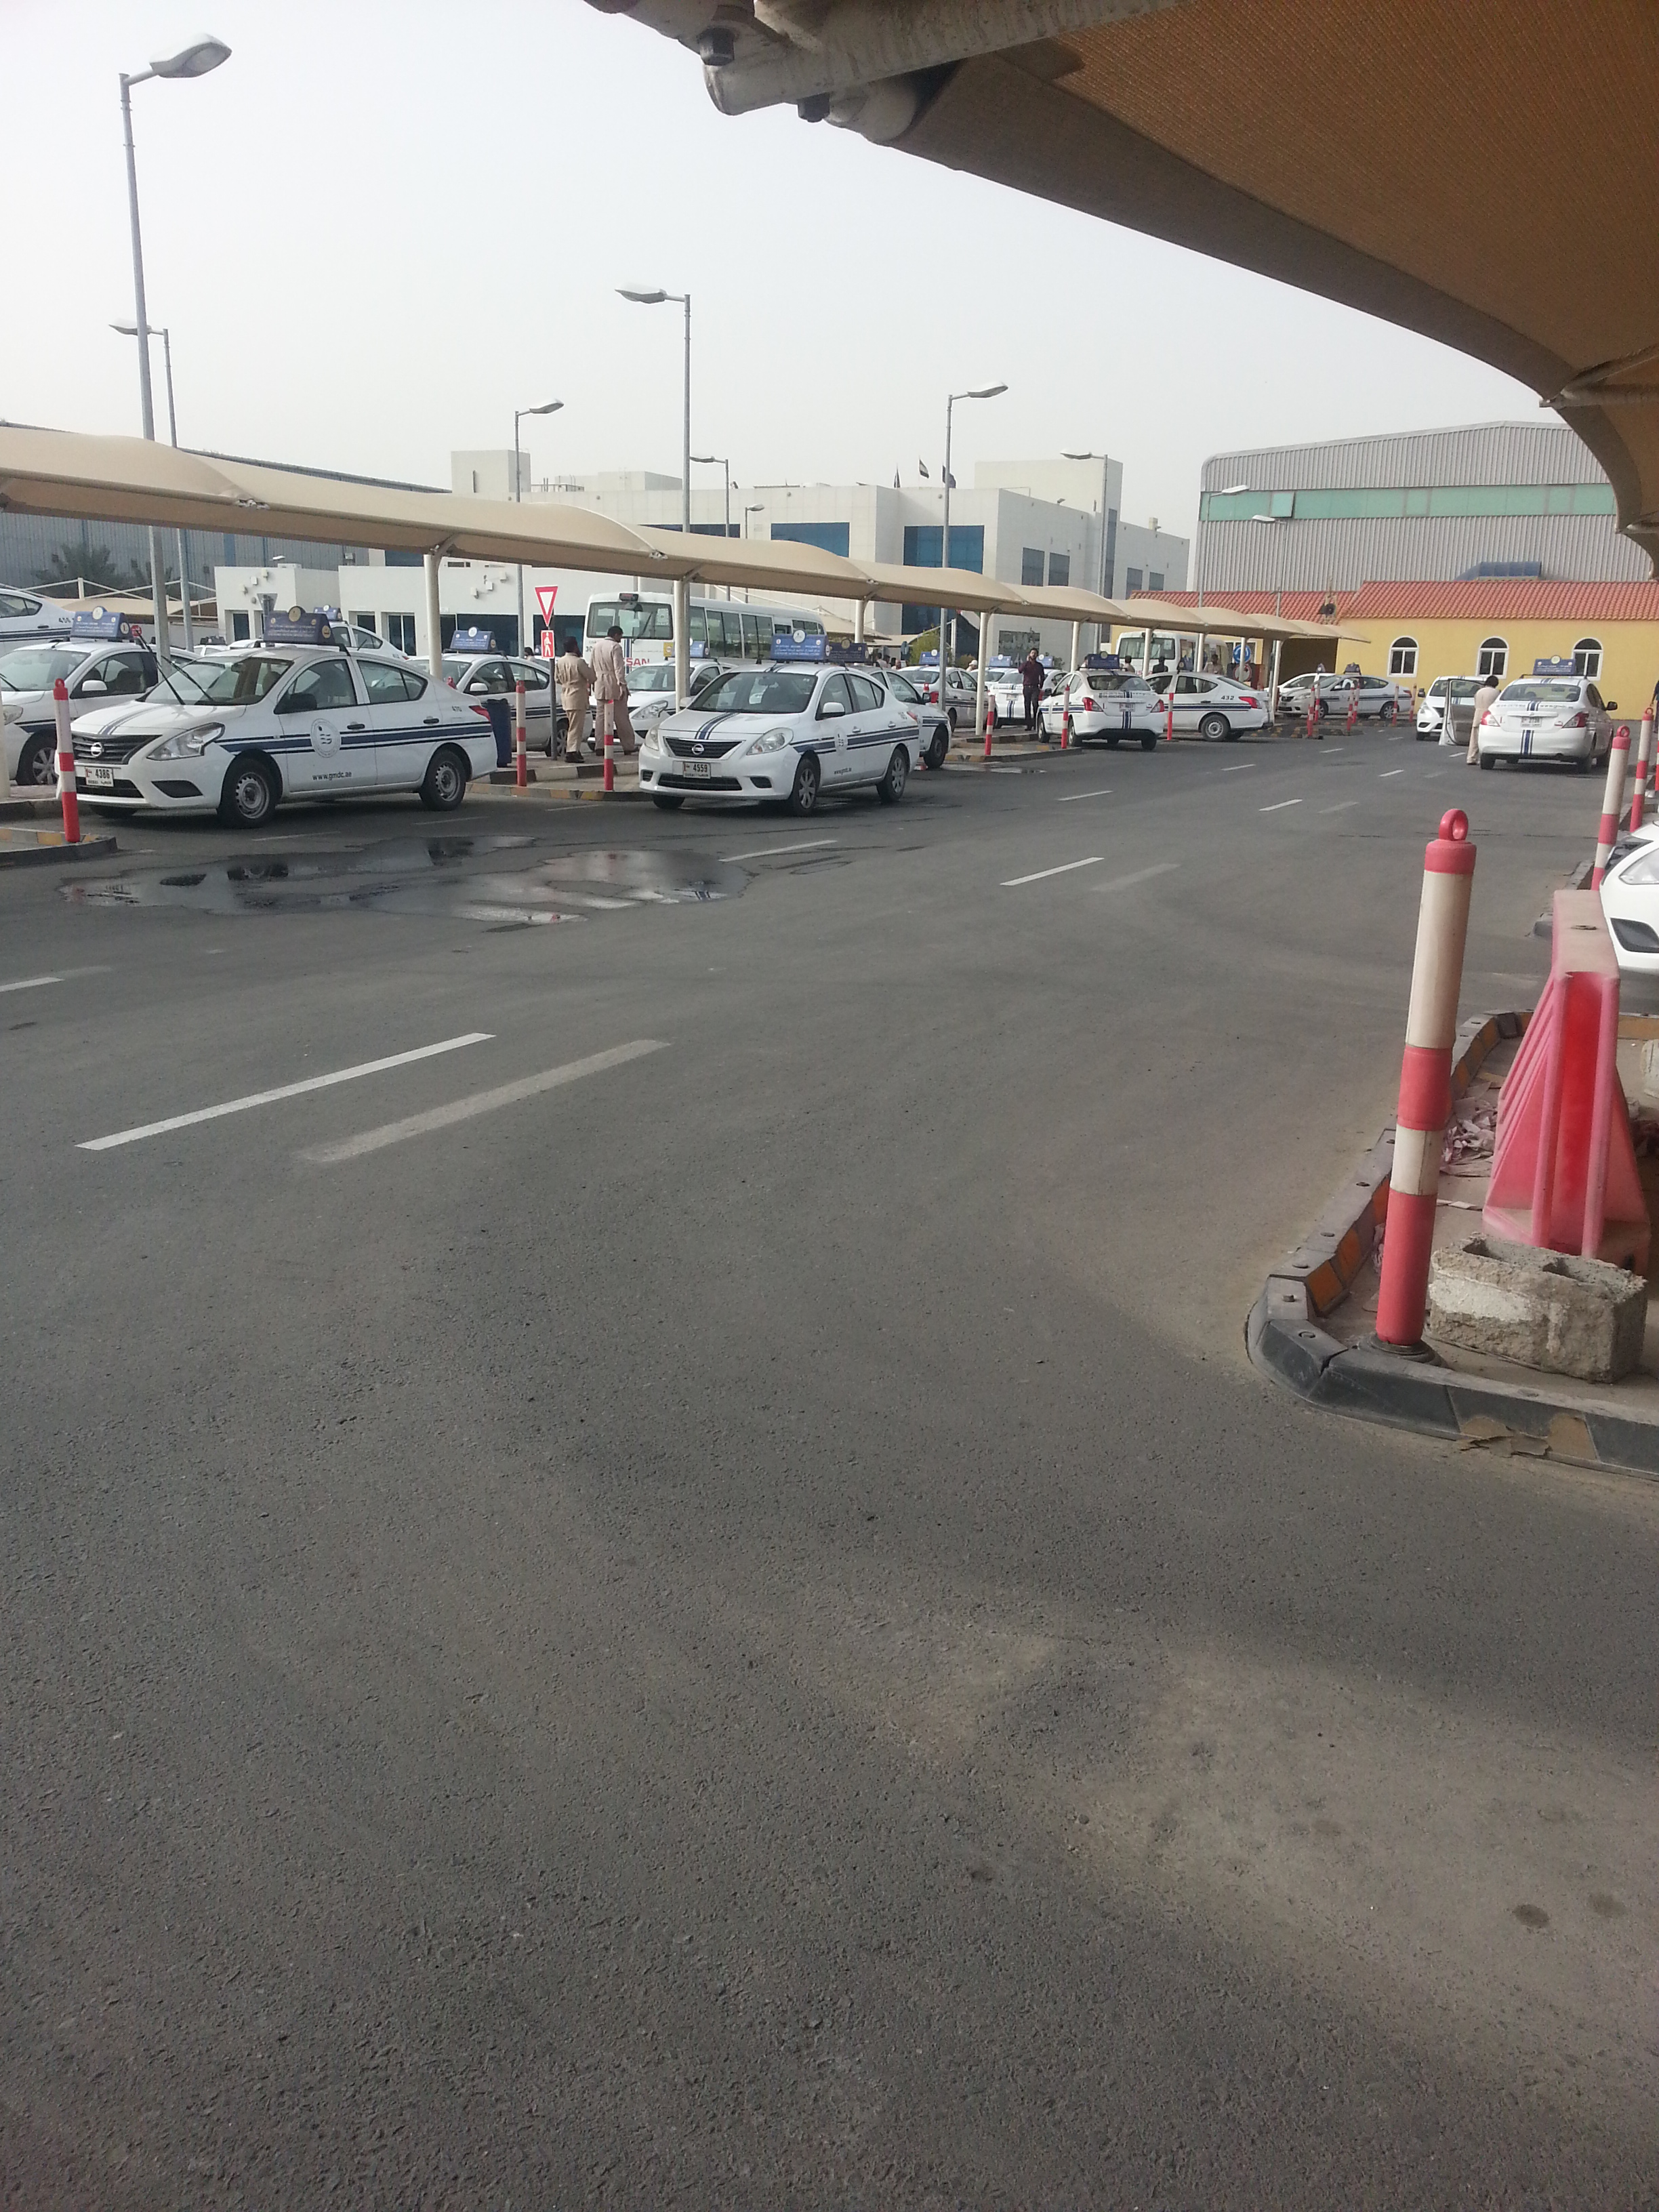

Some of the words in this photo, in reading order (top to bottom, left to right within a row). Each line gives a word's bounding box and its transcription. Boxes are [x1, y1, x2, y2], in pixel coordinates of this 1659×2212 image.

[693, 764, 708, 773] 4559
[95, 769, 110, 779] 4386
[312, 771, 352, 781] www.gmdc.ae
